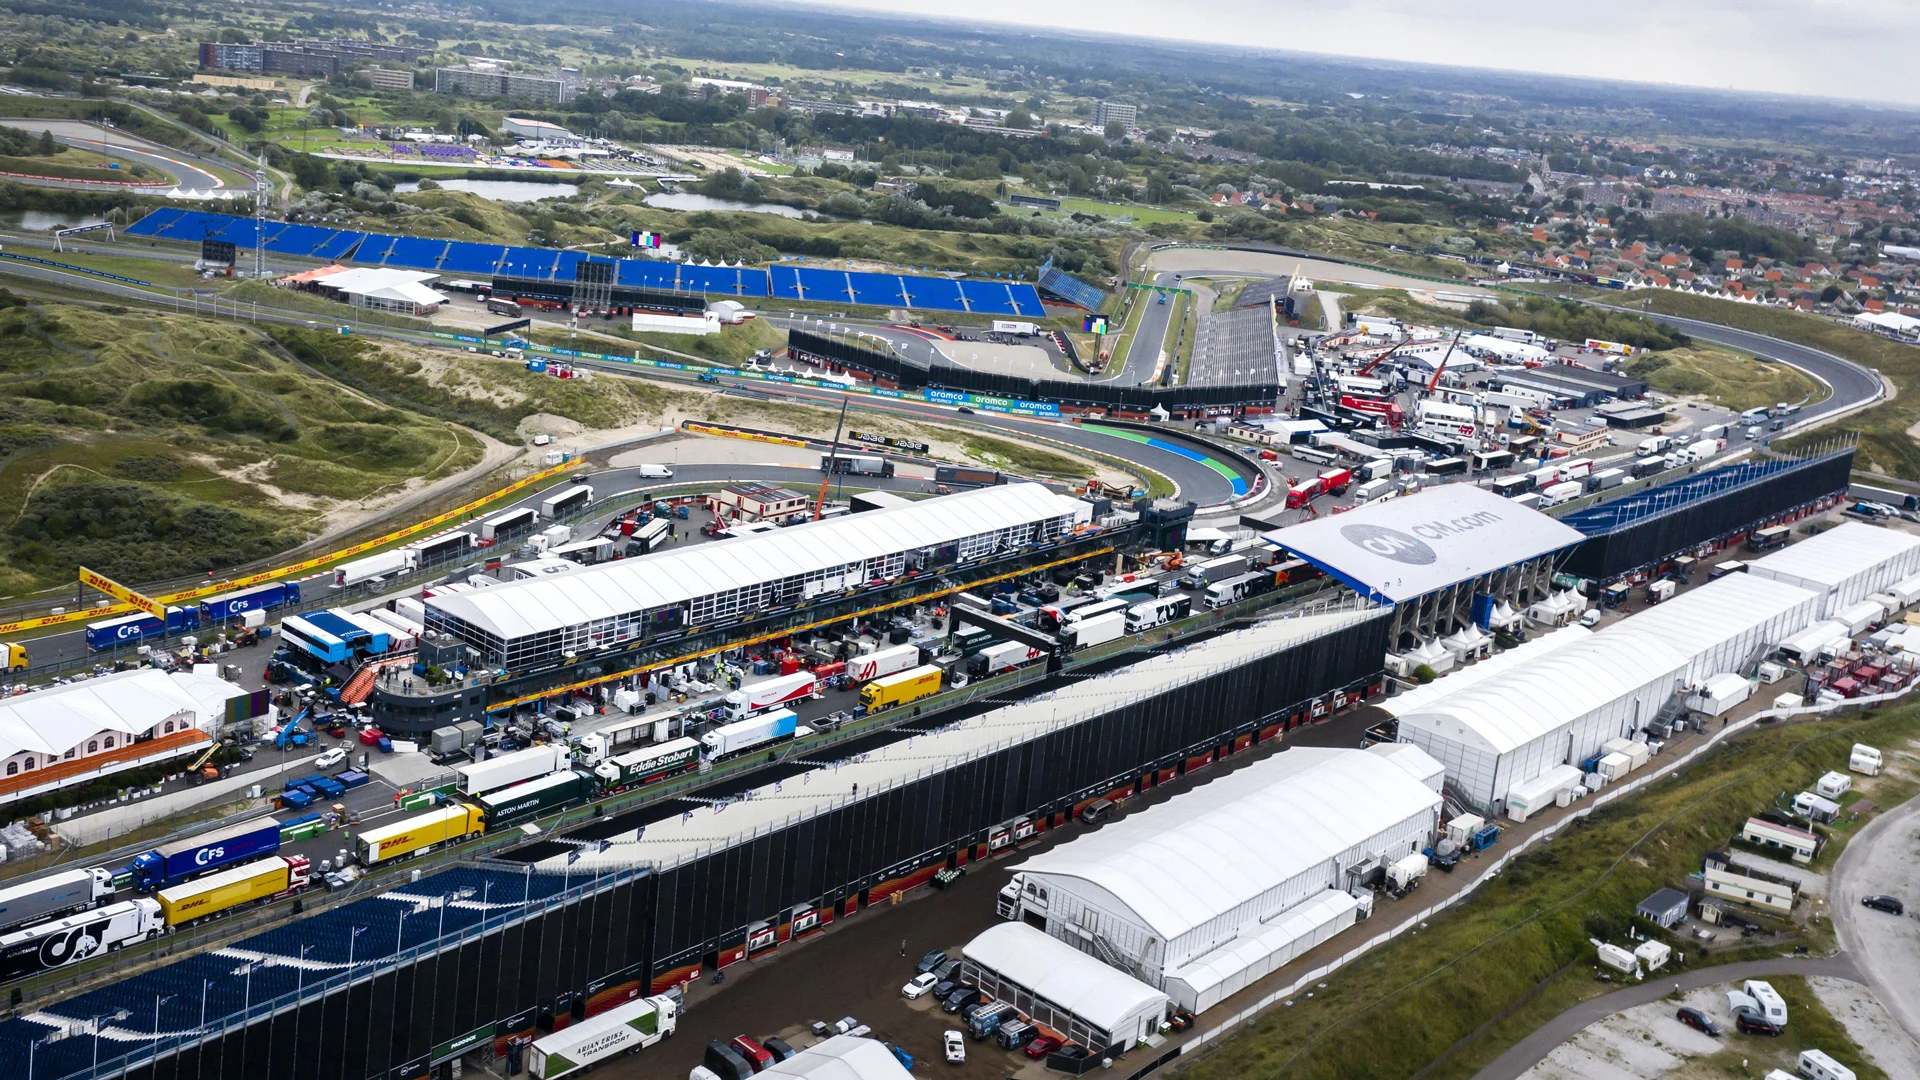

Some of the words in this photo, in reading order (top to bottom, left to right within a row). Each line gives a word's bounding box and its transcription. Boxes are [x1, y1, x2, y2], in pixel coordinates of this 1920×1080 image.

[768, 374, 789, 382] aramco
[931, 391, 963, 400] aramco
[975, 396, 1007, 406] aramco
[1020, 401, 1052, 410] aramco
[1412, 511, 1502, 540] CM.com
[399, 528, 413, 536] DHL
[374, 537, 388, 545] DHL
[347, 546, 362, 554] DHL
[318, 555, 334, 564] DHL
[287, 564, 304, 573] DHL
[253, 573, 272, 582] DHL
[216, 582, 237, 591] DHL
[89, 574, 114, 593] DHL
[129, 594, 154, 613] DHL
[177, 591, 198, 600] DHL
[229, 600, 249, 613] CFS
[89, 607, 114, 616] DHL
[42, 616, 68, 624] DHL
[0, 624, 19, 632] HL
[117, 625, 139, 638] CFS
[918, 674, 934, 684] DHL
[630, 758, 656, 774] Eddie
[657, 748, 694, 766] Stobart
[496, 806, 516, 817] ASTON
[517, 799, 540, 811] MARTIN
[380, 836, 410, 850] DHL
[195, 846, 224, 865] CFS
[181, 900, 205, 910] DHL
[601, 1030, 623, 1044] ERIKS
[451, 1035, 476, 1049] PADDOCK
[583, 1034, 630, 1057] TRANSPORT
